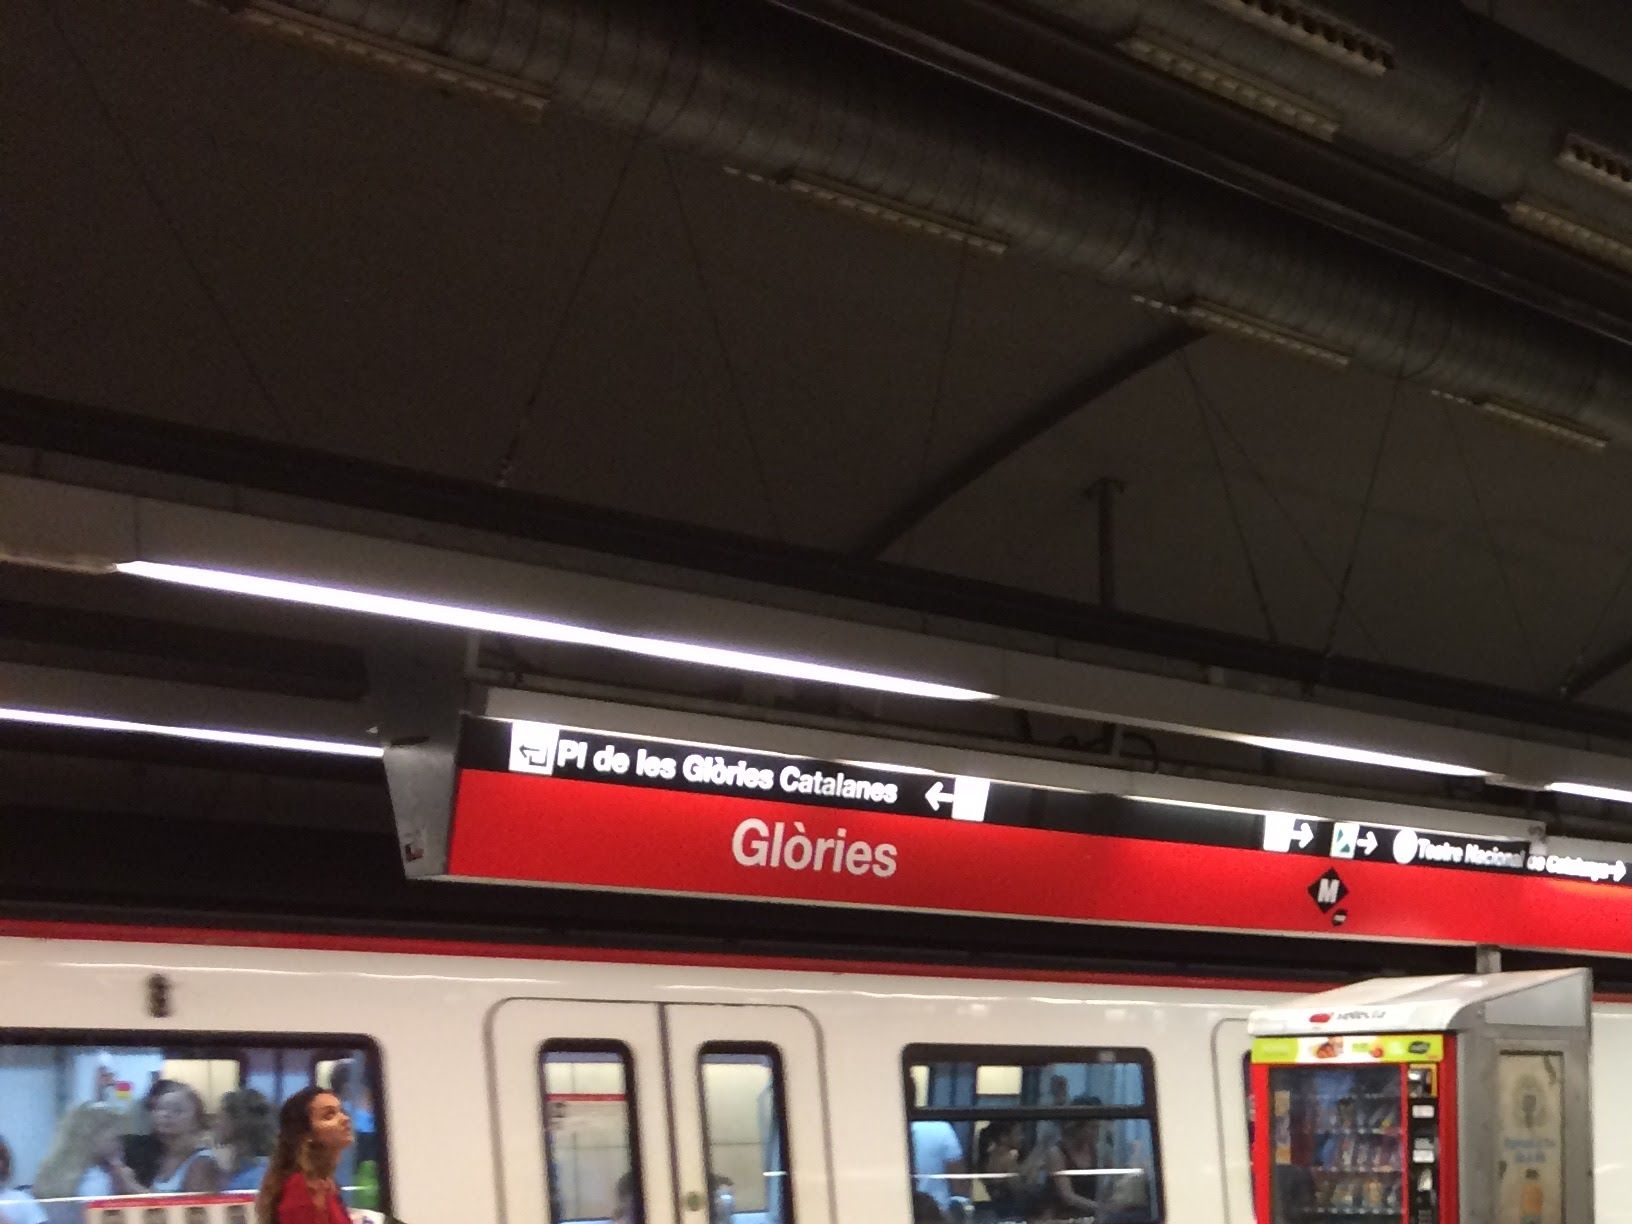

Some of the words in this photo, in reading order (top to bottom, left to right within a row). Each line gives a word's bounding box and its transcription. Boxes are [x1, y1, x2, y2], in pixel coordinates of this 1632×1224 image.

[557, 739, 588, 769] Pl
[593, 744, 630, 774] de
[635, 748, 677, 779] les
[682, 754, 774, 790] Glòries
[779, 765, 898, 803] Catalanes
[732, 818, 898, 877] Glòries
